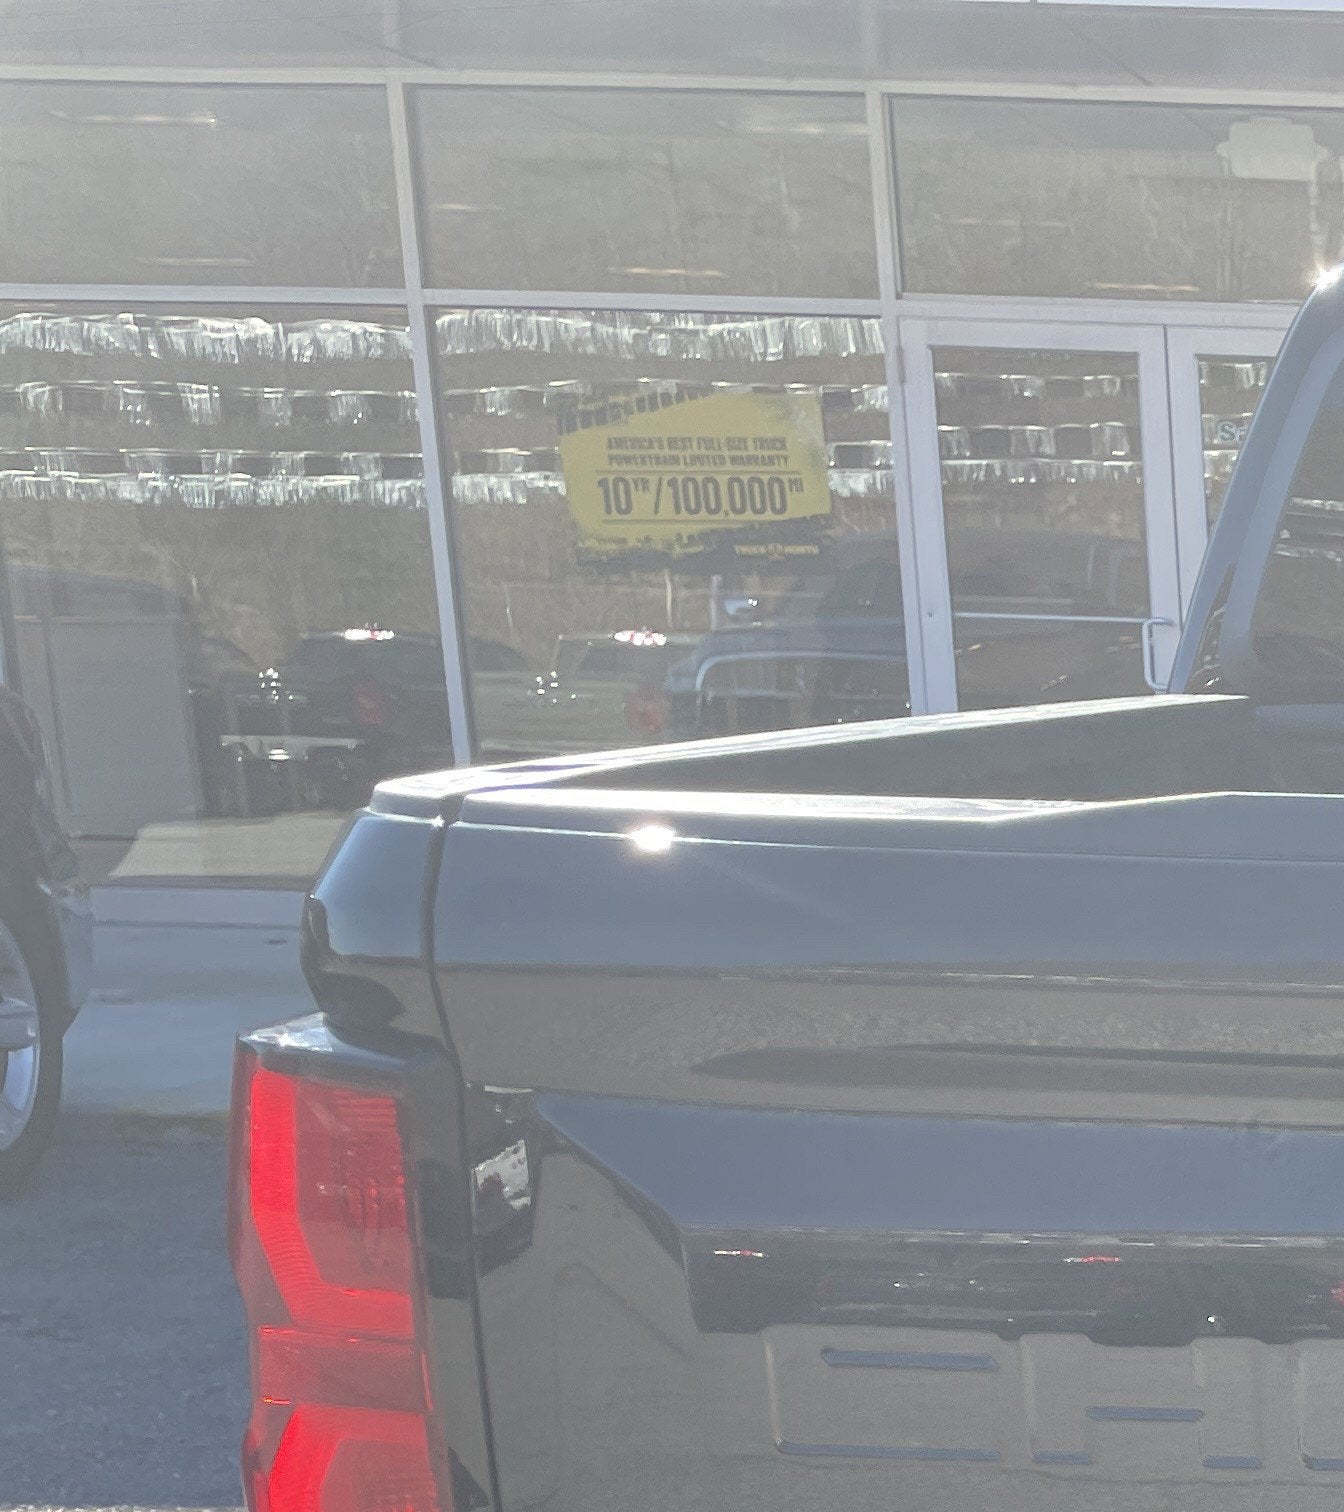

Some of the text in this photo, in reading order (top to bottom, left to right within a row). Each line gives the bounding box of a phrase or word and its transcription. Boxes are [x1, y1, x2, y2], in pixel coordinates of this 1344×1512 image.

[607, 454, 789, 467] POWERTRAIN LIMITED WARRANTY
